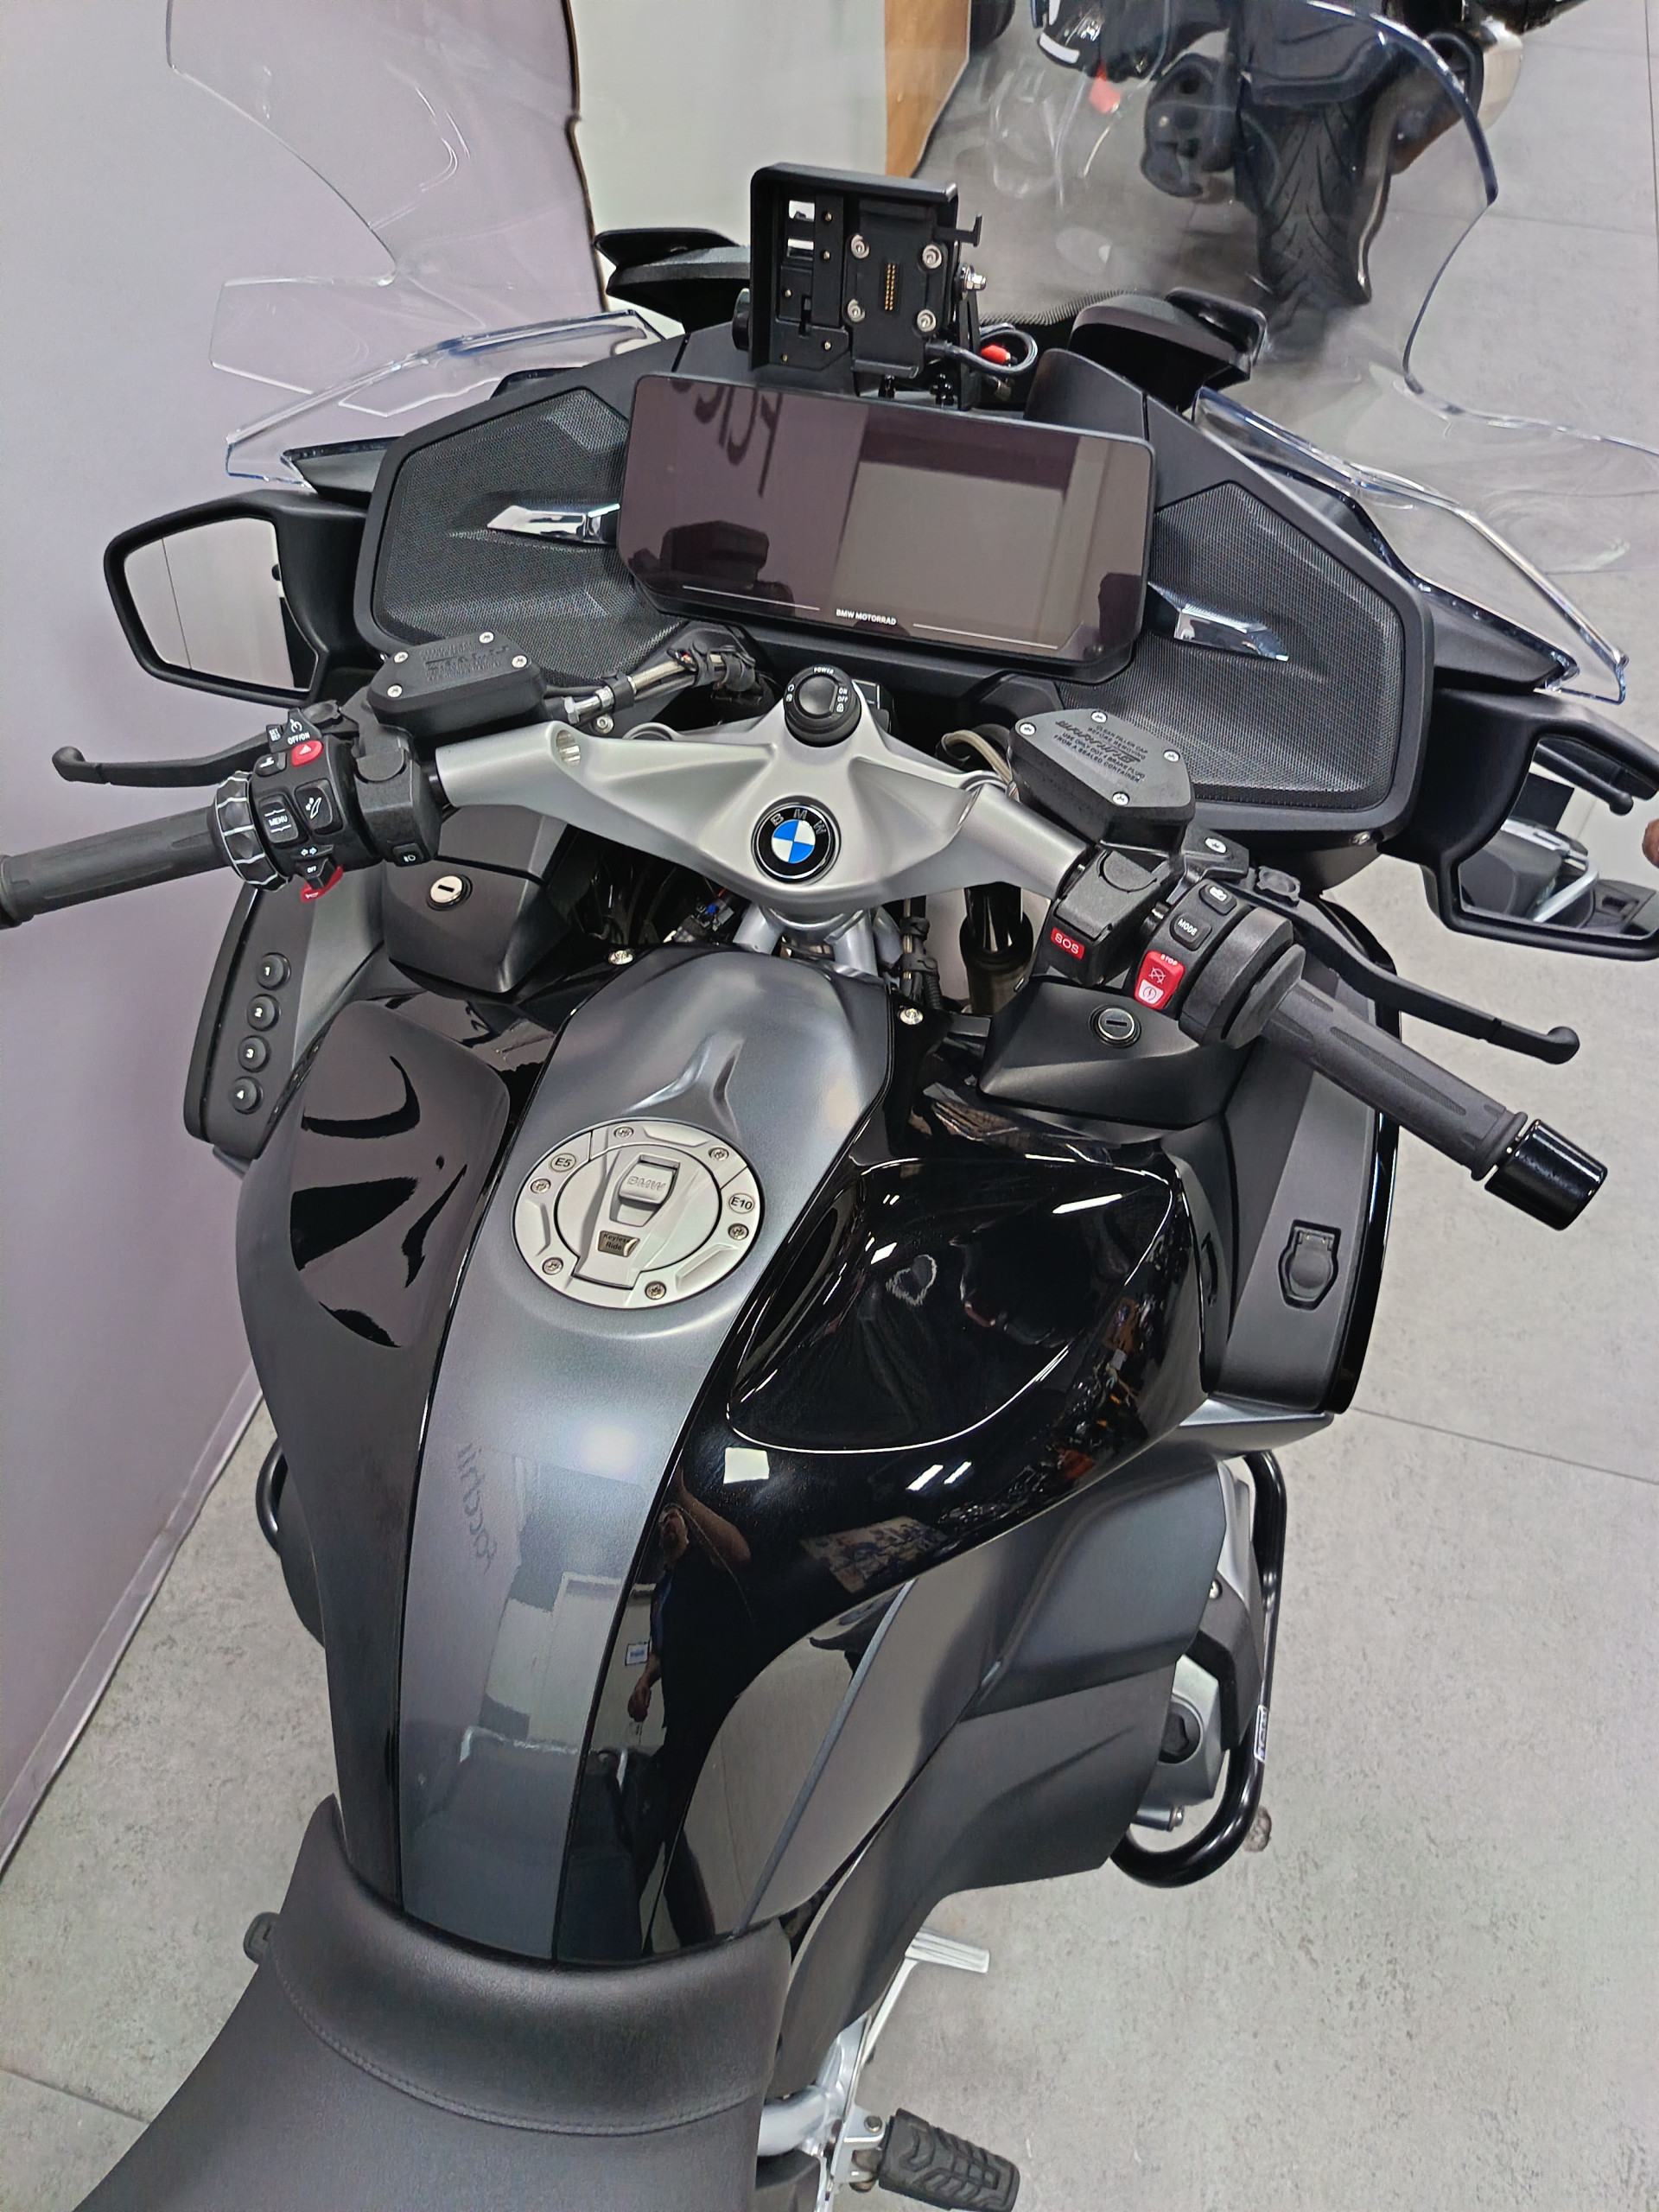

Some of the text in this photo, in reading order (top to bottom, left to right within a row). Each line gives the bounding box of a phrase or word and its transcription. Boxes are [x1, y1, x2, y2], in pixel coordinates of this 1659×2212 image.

[836, 608, 897, 626] BMW MOTORRAD
[813, 666, 834, 675] POWER
[287, 731, 311, 745] OFF/ON
[268, 815, 288, 827] MENU
[770, 808, 827, 836] BMW
[1177, 918, 1198, 937] MODE
[1054, 932, 1079, 955] SOS
[1160, 953, 1179, 966] STOP
[264, 966, 270, 976] 1
[254, 1007, 263, 1018] 2
[245, 1048, 254, 1058] 3
[237, 1090, 245, 1100] 4
[555, 1157, 573, 1167] E5
[627, 1175, 666, 1192] BMW
[730, 1196, 753, 1210] E10
[603, 1233, 632, 1243] Keyless
[606, 1242, 622, 1251] Ride
